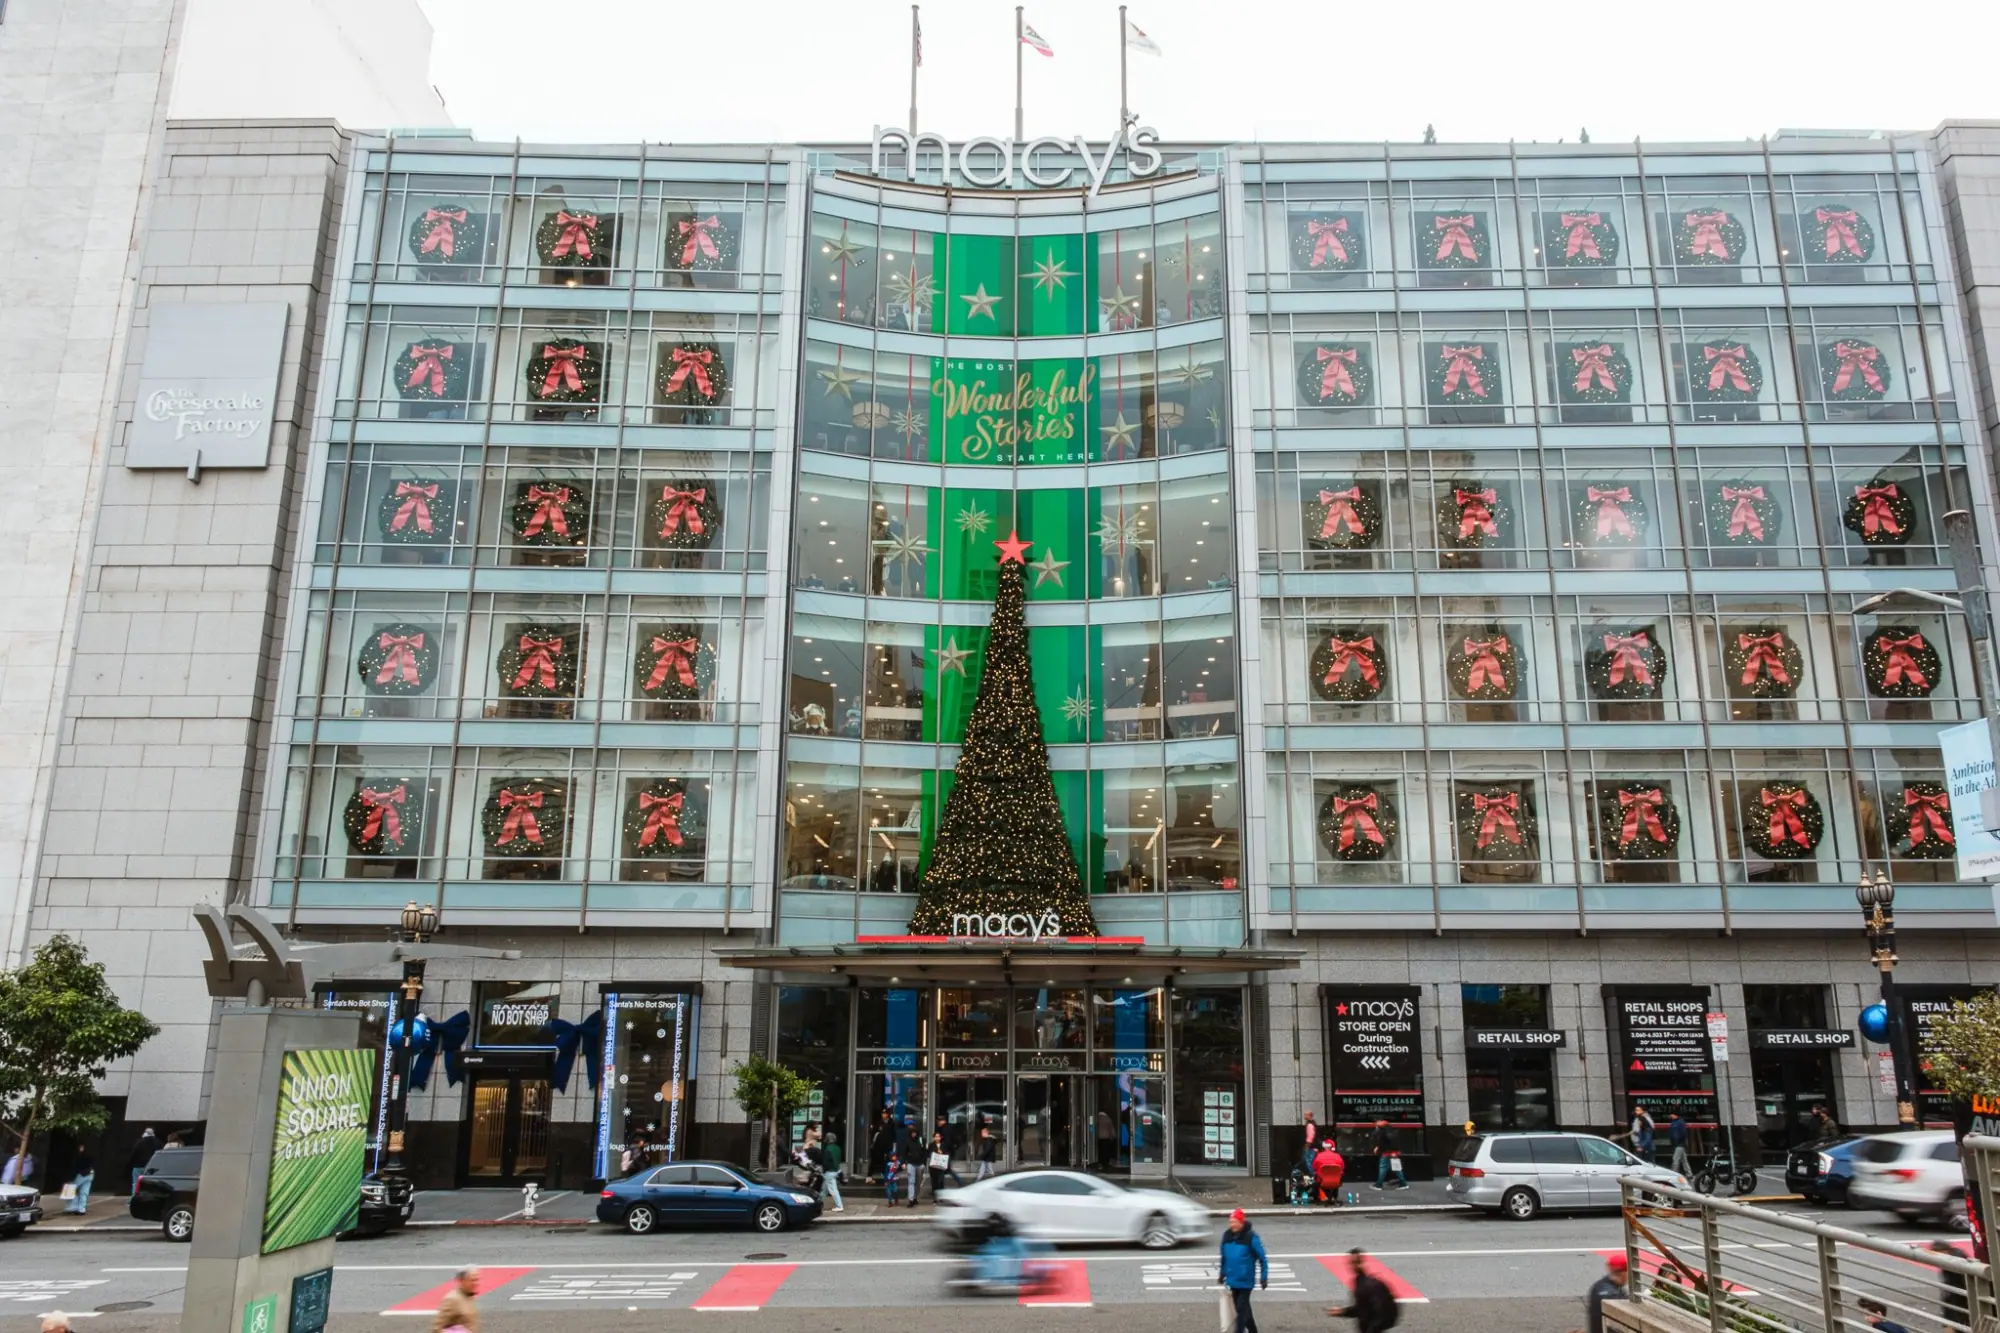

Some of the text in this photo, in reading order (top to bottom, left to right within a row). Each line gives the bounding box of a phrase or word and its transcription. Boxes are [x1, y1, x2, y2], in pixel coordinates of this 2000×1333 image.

[871, 111, 1163, 197] macy's
[935, 360, 1014, 371] THE MOST
[932, 364, 1096, 419] Wonderful
[146, 388, 264, 422] Cheesecake
[169, 410, 262, 441] Factory
[961, 412, 1075, 460] Stories
[997, 452, 1095, 462] START HERE
[1954, 774, 1998, 797] in the Ai
[953, 907, 1060, 941] macy's
[372, 1000, 390, 1009] Shop
[658, 1001, 676, 1009] Shop
[1350, 998, 1414, 1020] macy's
[1625, 1003, 1704, 1012] RETAIL SHOPS
[1912, 1002, 1951, 1012] RETAIL
[491, 1010, 505, 1026] NO
[506, 1010, 523, 1026] BOT
[1630, 1015, 1657, 1025] FOR
[1660, 1015, 1701, 1025] LEASE
[1339, 1022, 1411, 1032] STORE OPEN
[1358, 1034, 1393, 1045] During
[1478, 1033, 1561, 1043] RETAIL SHOP
[1767, 1034, 1851, 1044] RETAIL SHOP
[1343, 1043, 1409, 1054] Construction
[952, 1055, 991, 1068] macy's
[1031, 1055, 1069, 1068] macy's
[291, 1072, 351, 1103] UNION
[287, 1103, 360, 1136] SQUARE
[285, 1136, 335, 1160] GARAGE
